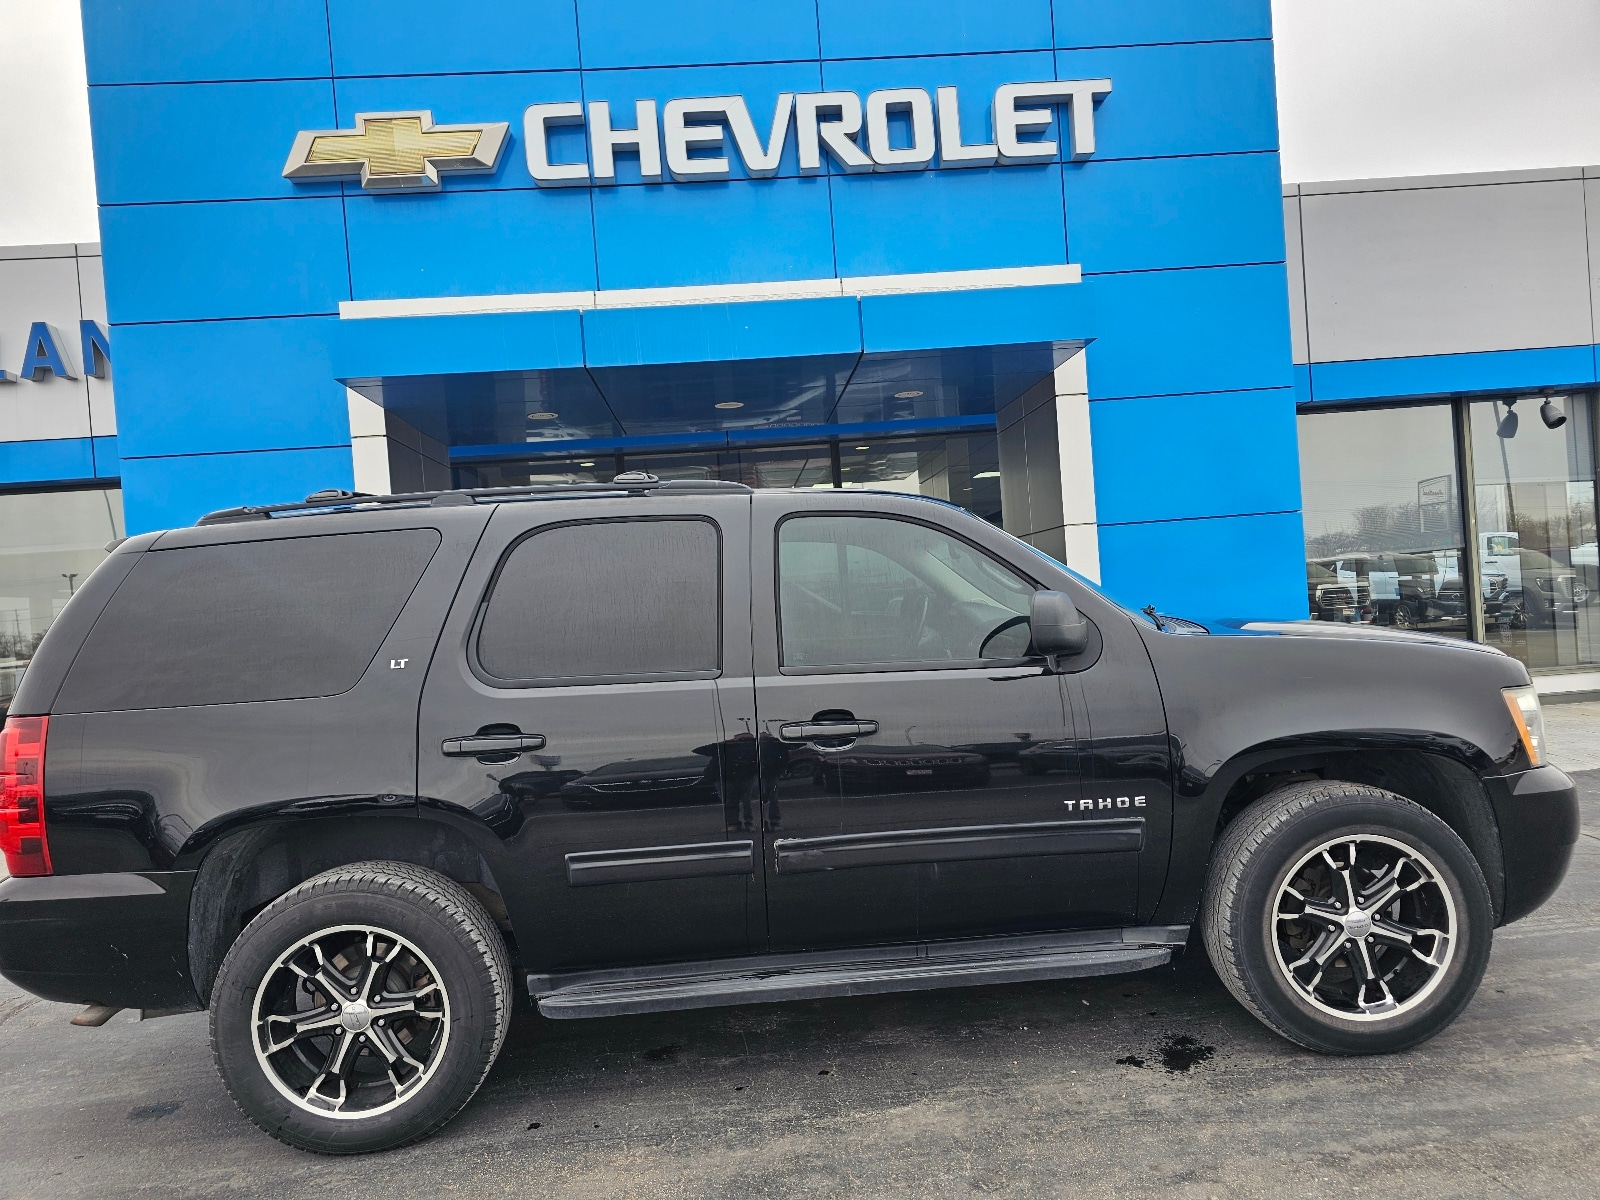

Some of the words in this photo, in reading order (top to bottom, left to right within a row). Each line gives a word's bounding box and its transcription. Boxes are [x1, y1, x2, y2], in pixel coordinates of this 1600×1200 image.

[523, 78, 1112, 187] CHEVROLET
[0, 320, 111, 382] AN
[390, 658, 409, 670] LT
[1063, 795, 1147, 812] TAHOE
